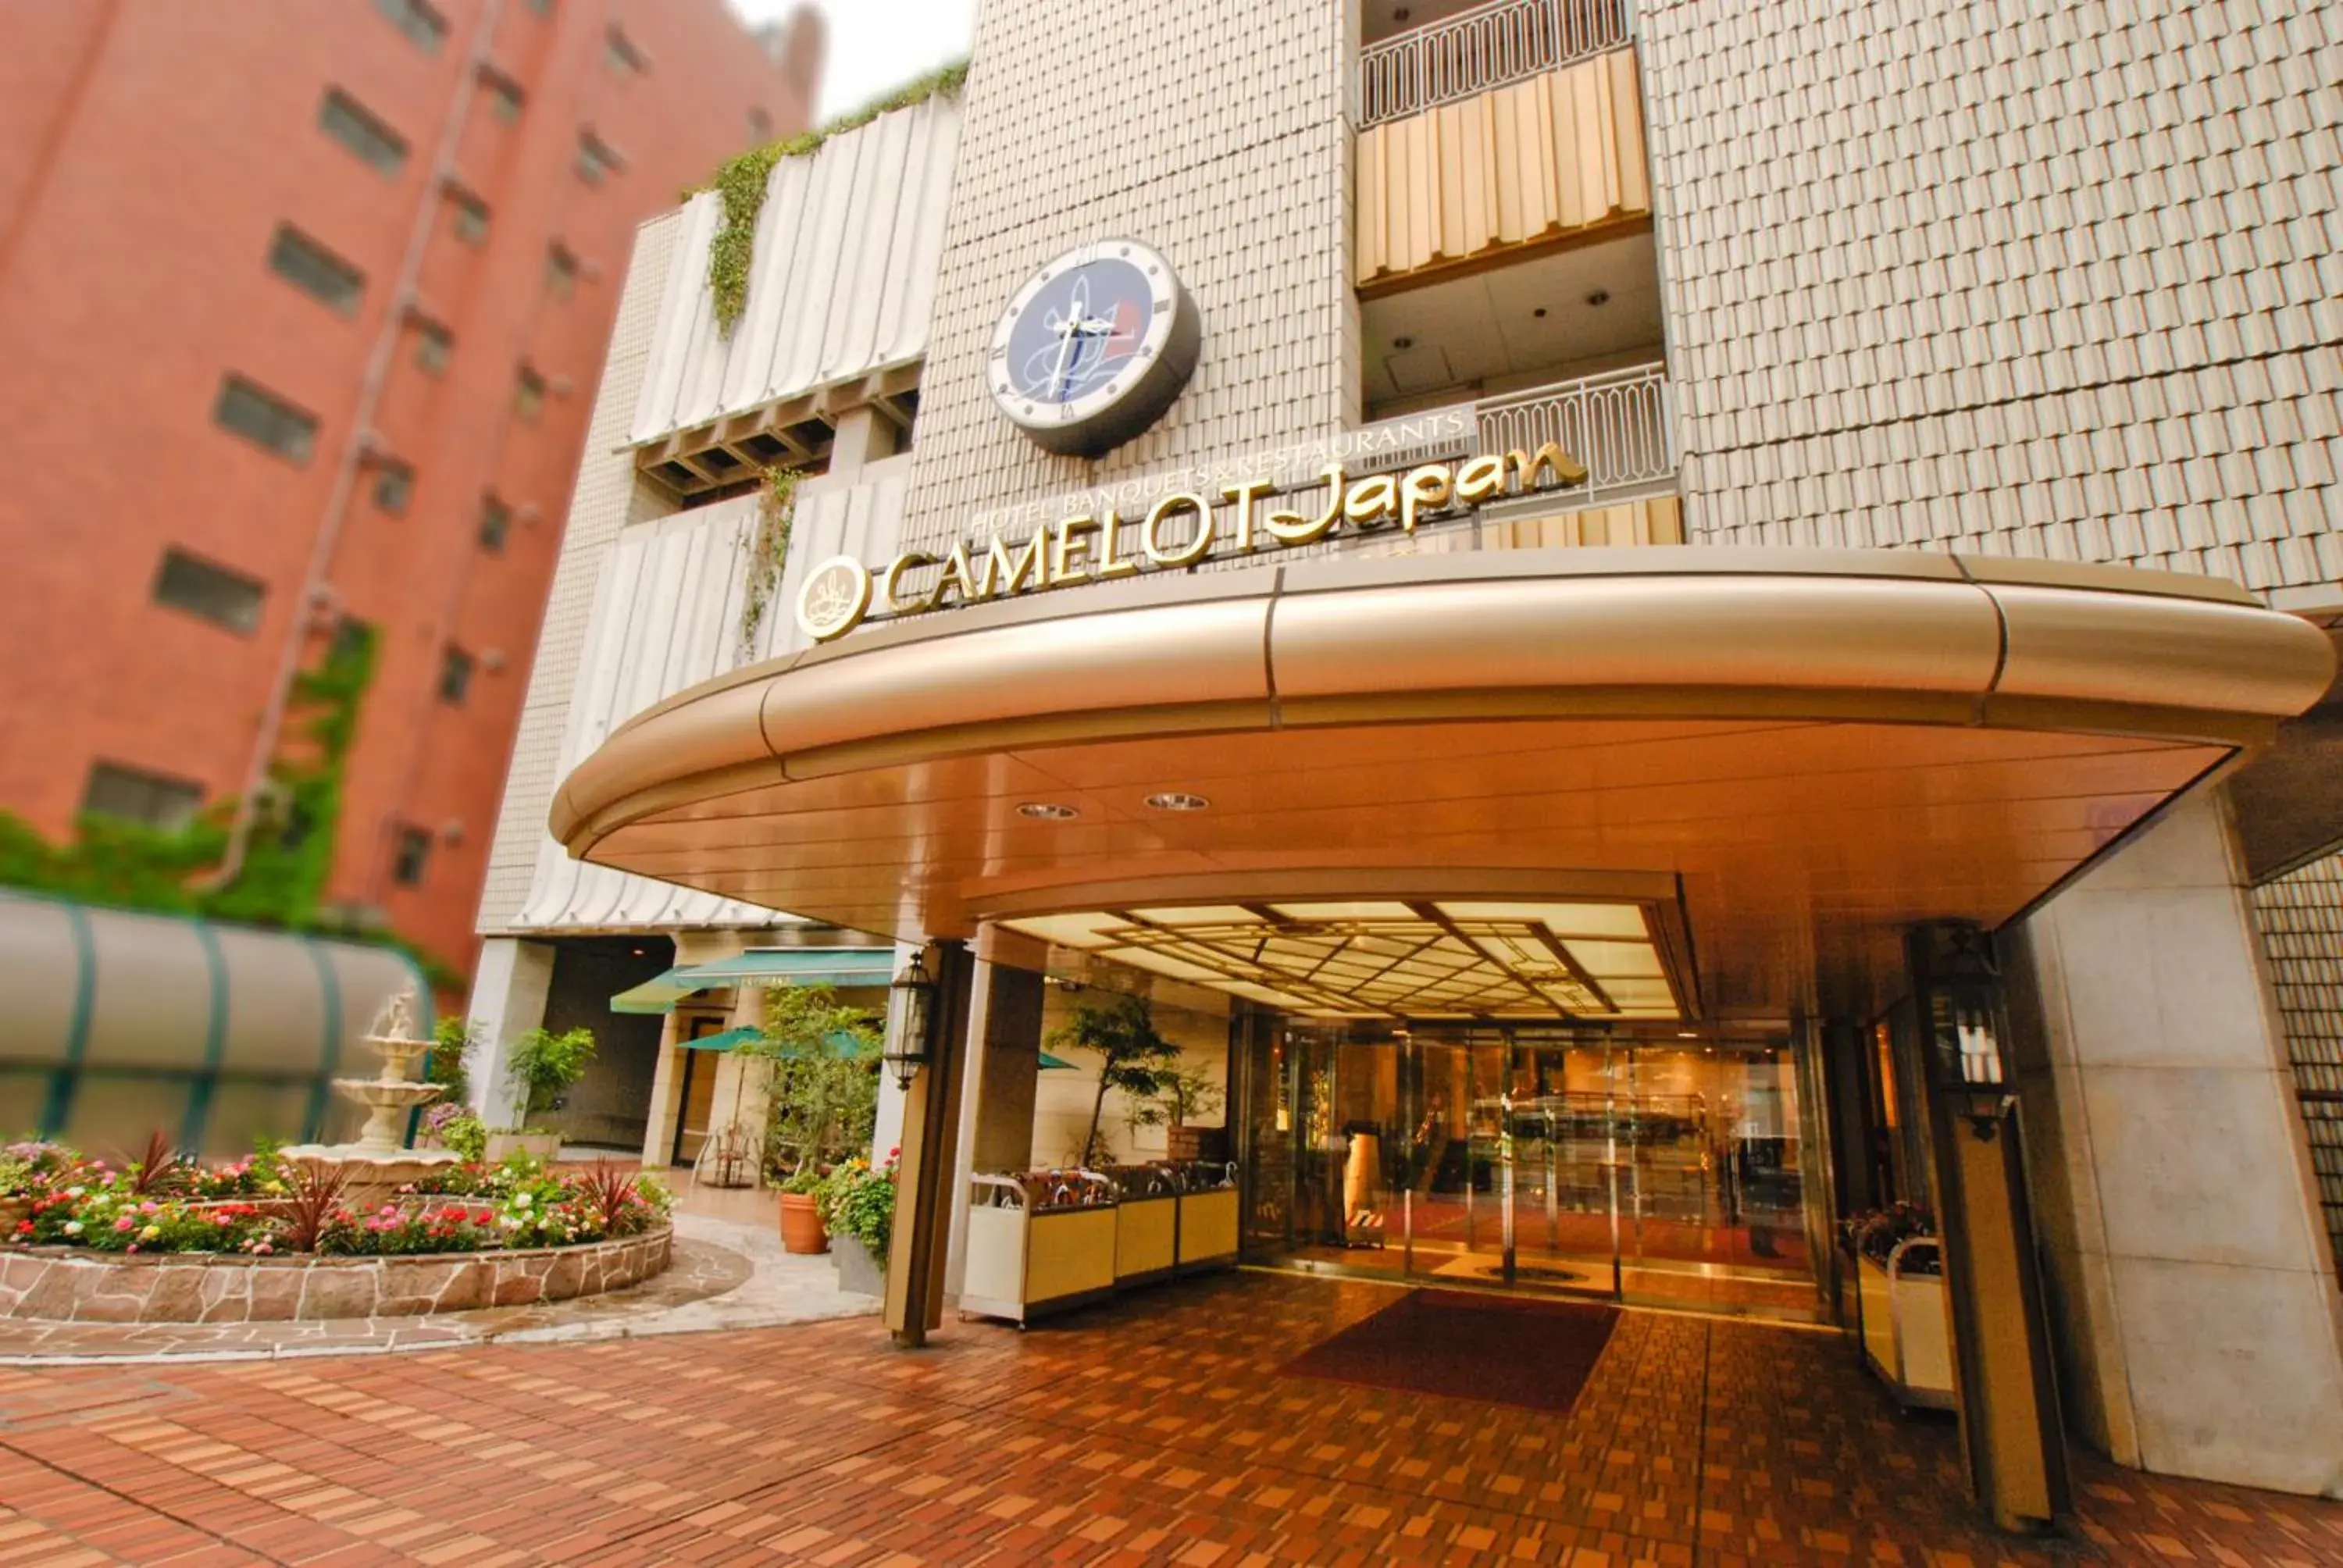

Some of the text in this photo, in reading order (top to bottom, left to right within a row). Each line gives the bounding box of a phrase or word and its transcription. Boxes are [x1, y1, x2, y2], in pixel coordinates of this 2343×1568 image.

[883, 441, 1589, 615] CAMELOT Japan
[971, 410, 1464, 533] HOTEL BANQUETS & RESTAURANTS
